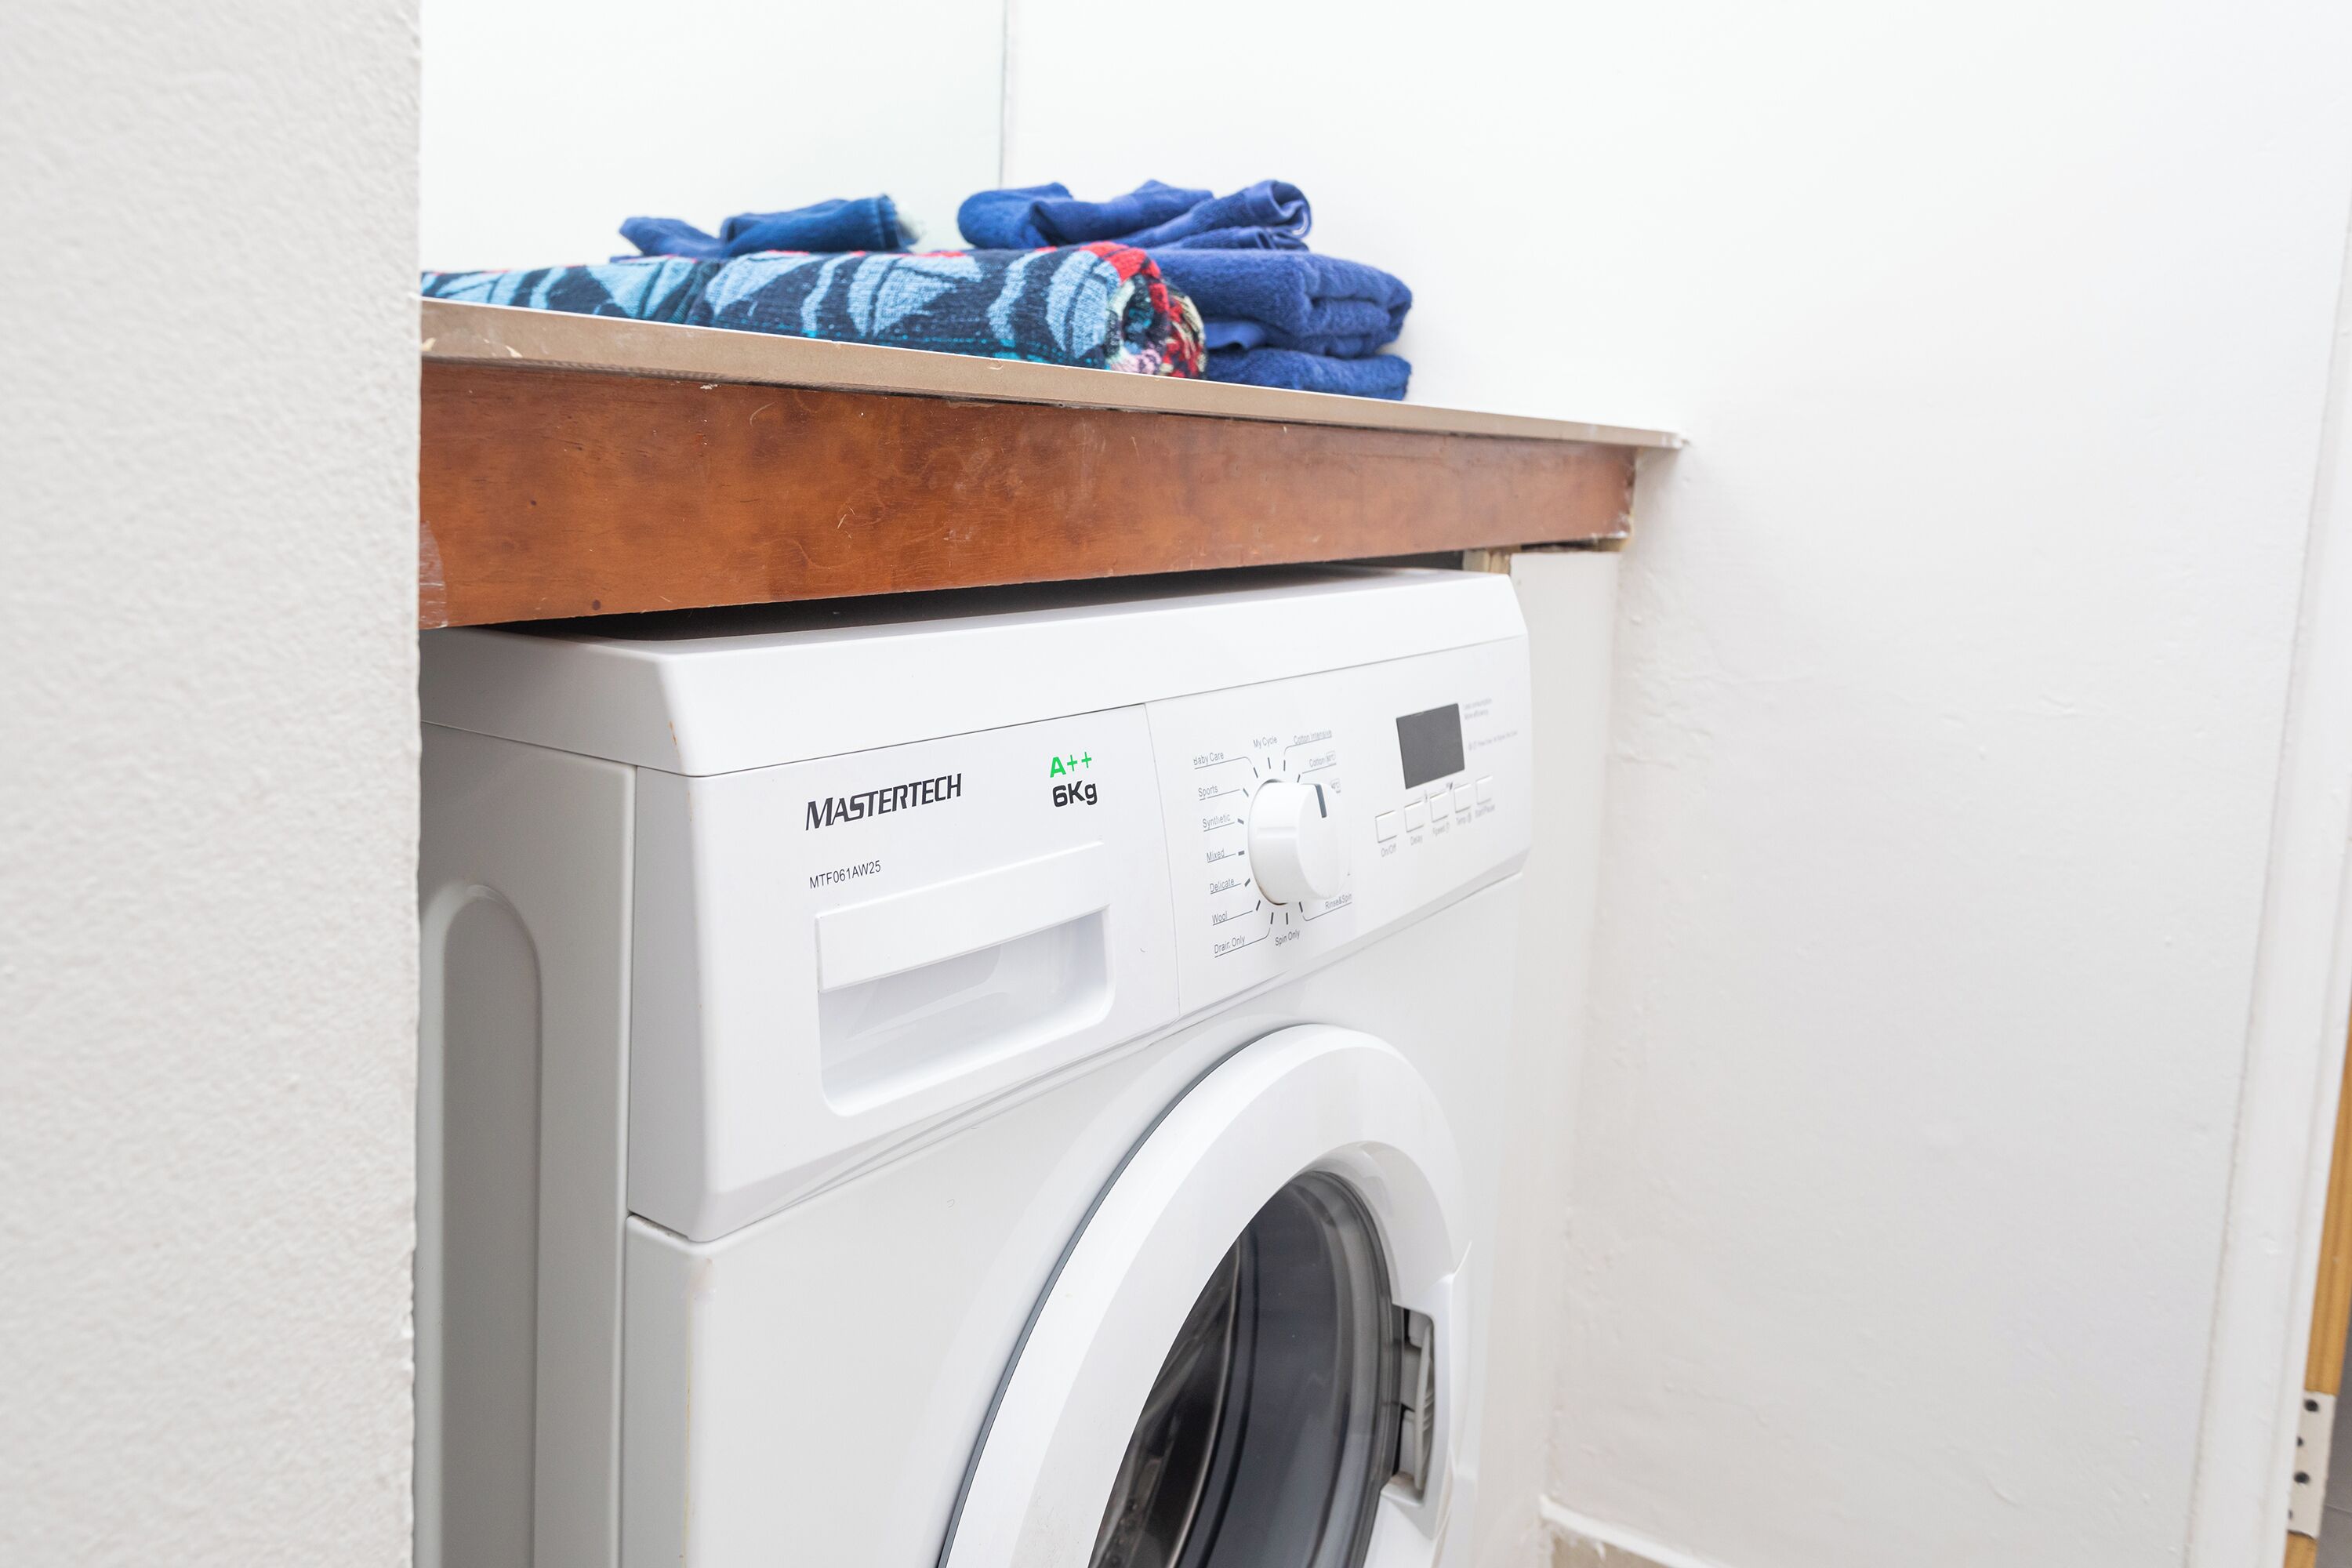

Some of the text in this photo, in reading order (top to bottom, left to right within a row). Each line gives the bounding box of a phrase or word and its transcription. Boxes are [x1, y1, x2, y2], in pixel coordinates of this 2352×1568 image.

[1254, 735, 1278, 749] My Cycle
[1050, 751, 1092, 778] A++
[1209, 752, 1225, 762] Care
[1052, 780, 1098, 808] 6Kg
[1198, 785, 1218, 800] Sports
[805, 773, 962, 830] MASTERTECH
[1202, 813, 1231, 830] Synthetic
[1207, 848, 1225, 862] Mixed
[809, 859, 881, 889] MTF061AW25
[1209, 877, 1235, 893] Delicate
[1325, 892, 1353, 910] Rinse&Spin
[1212, 910, 1228, 924] Wool
[1231, 935, 1247, 947] Only
[1275, 928, 1301, 947] Spin Only
